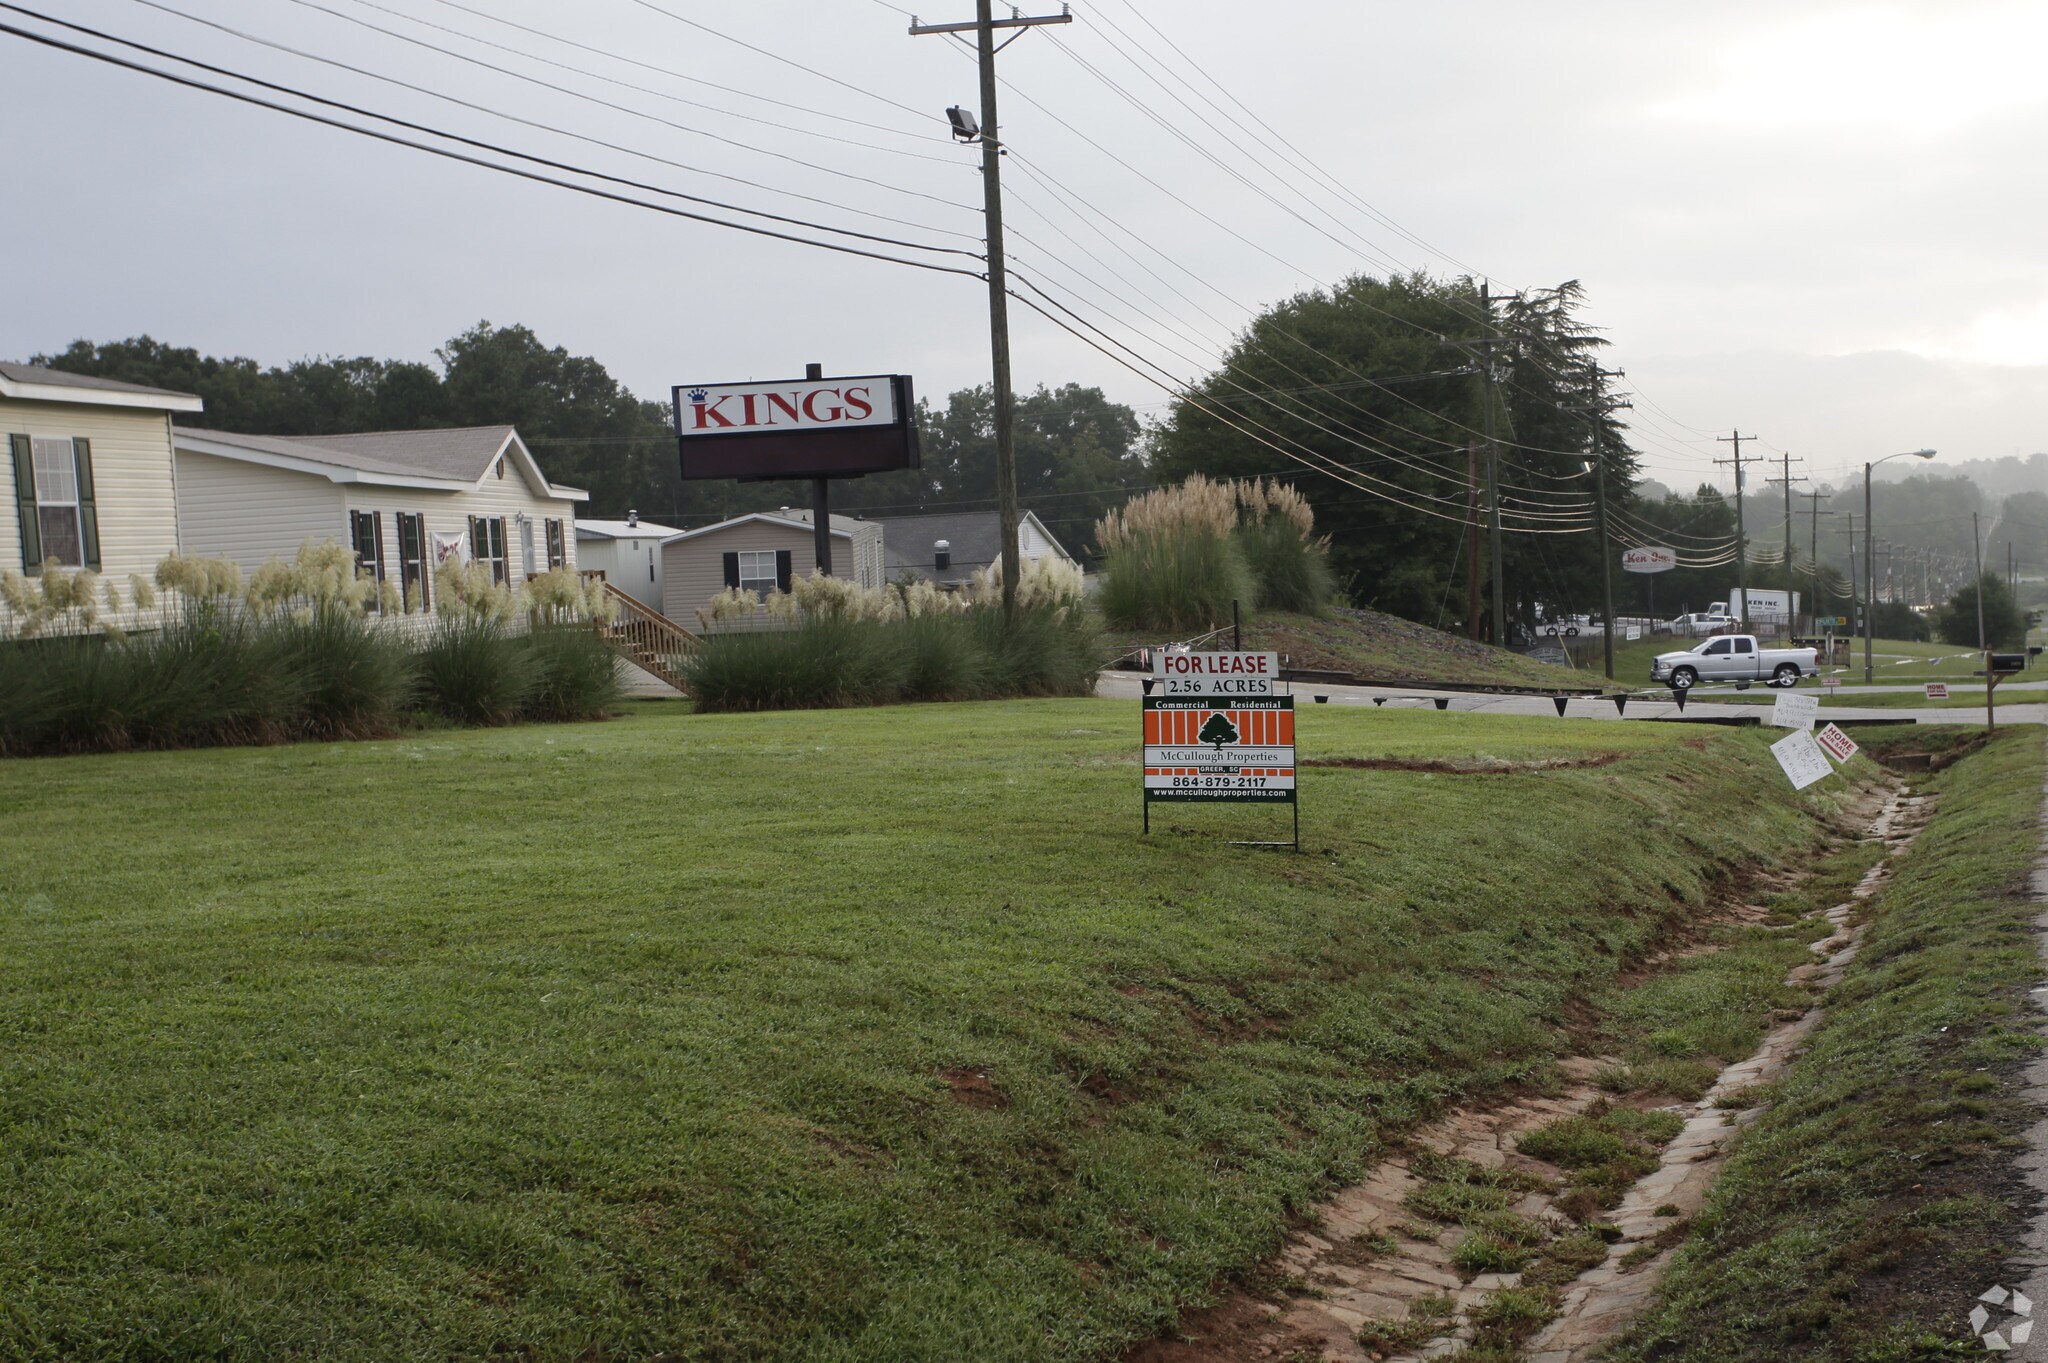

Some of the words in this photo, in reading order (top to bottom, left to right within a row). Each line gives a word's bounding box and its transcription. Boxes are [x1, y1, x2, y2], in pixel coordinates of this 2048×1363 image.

[689, 387, 873, 429] KINGS
[1627, 553, 1647, 563] Ken
[1164, 656, 1203, 674] FOR
[1208, 656, 1267, 674] LEASE
[1169, 680, 1202, 693] 2.56
[1212, 680, 1267, 693] ACRES
[1155, 700, 1209, 709] Commercial
[1230, 700, 1281, 709] Residential
[1822, 731, 1835, 744] FOR
[1834, 742, 1850, 757] SALE
[1828, 727, 1854, 752] HOME
[1161, 751, 1224, 763] McCullough
[1227, 751, 1278, 763] Properties
[1172, 777, 1267, 787] 864-879-2117
[1153, 789, 1287, 798] www.mcculloughproperties.com
